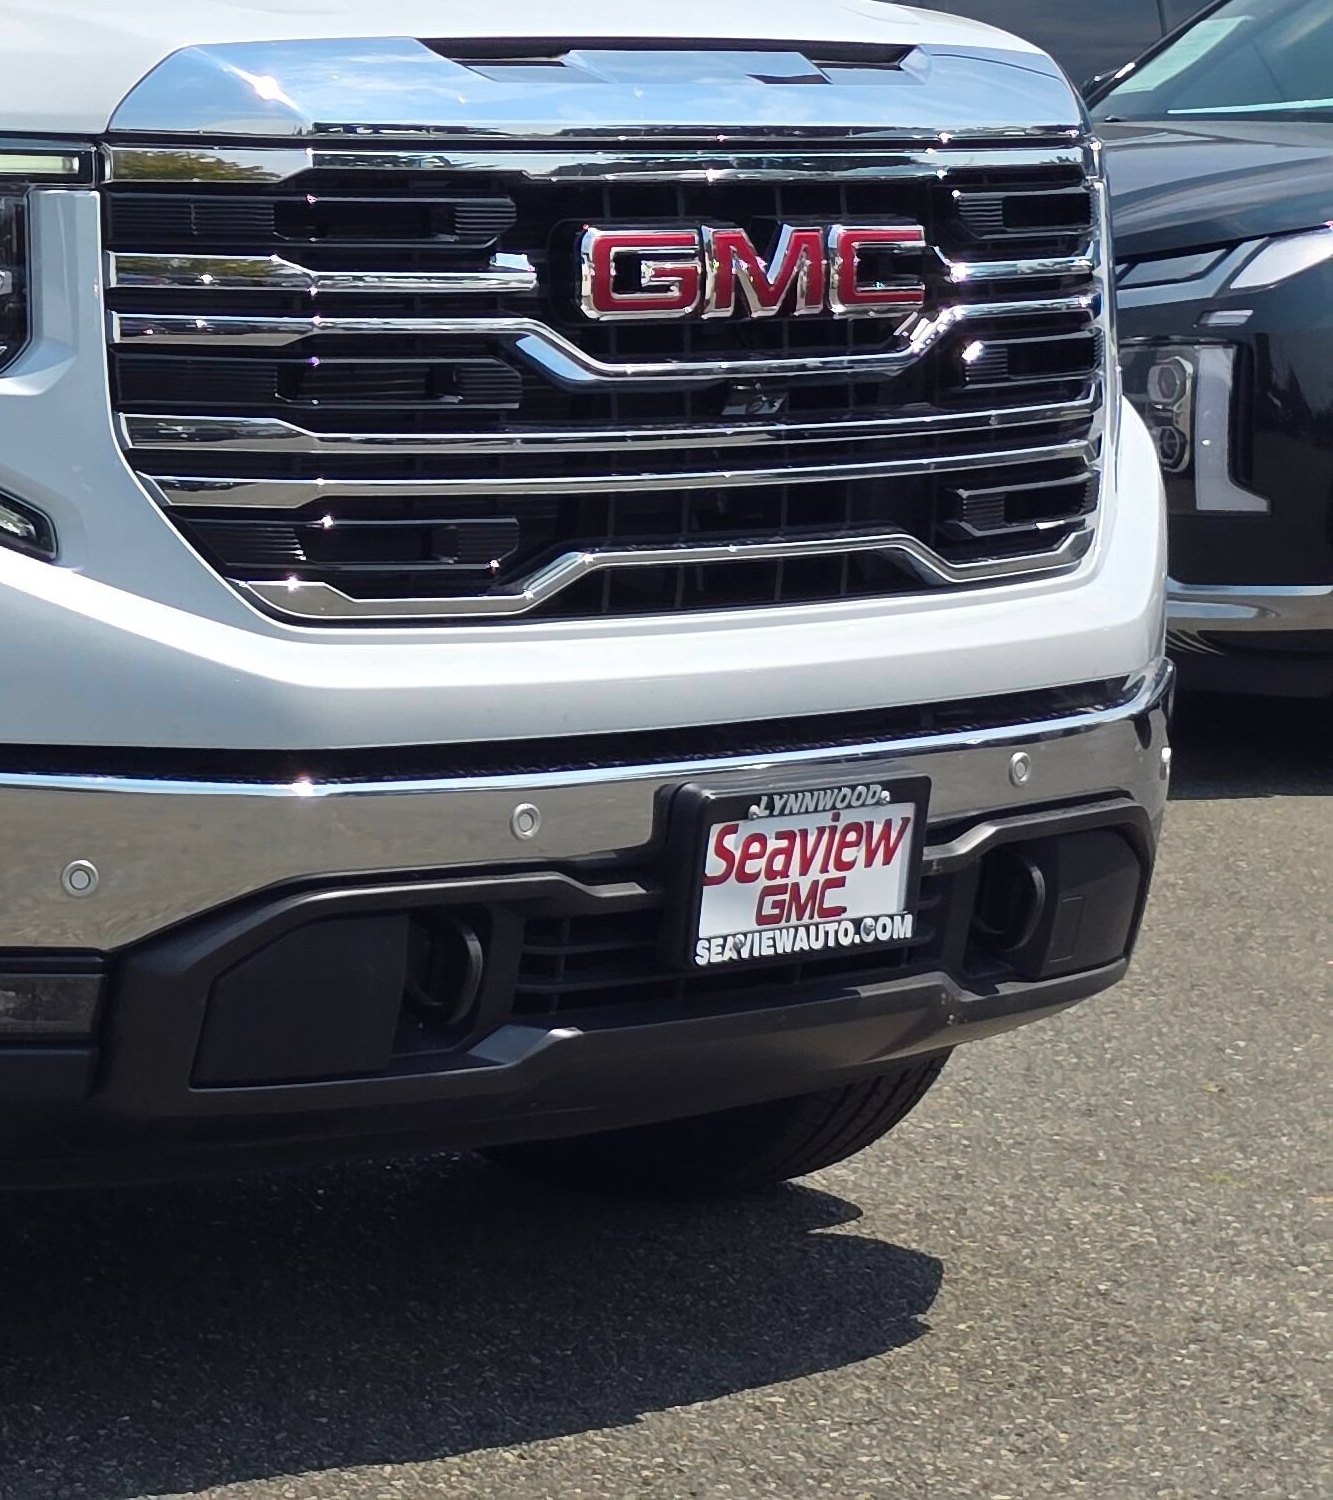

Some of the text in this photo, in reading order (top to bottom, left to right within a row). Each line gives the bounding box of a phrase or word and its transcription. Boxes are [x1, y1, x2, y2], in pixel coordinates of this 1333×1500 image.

[580, 222, 928, 322] GMC
[756, 783, 883, 818] LYNNWOOD
[701, 811, 912, 887] Seaview
[755, 875, 848, 927] GMC
[694, 913, 915, 966] SEAVIEWAUTO.COM
